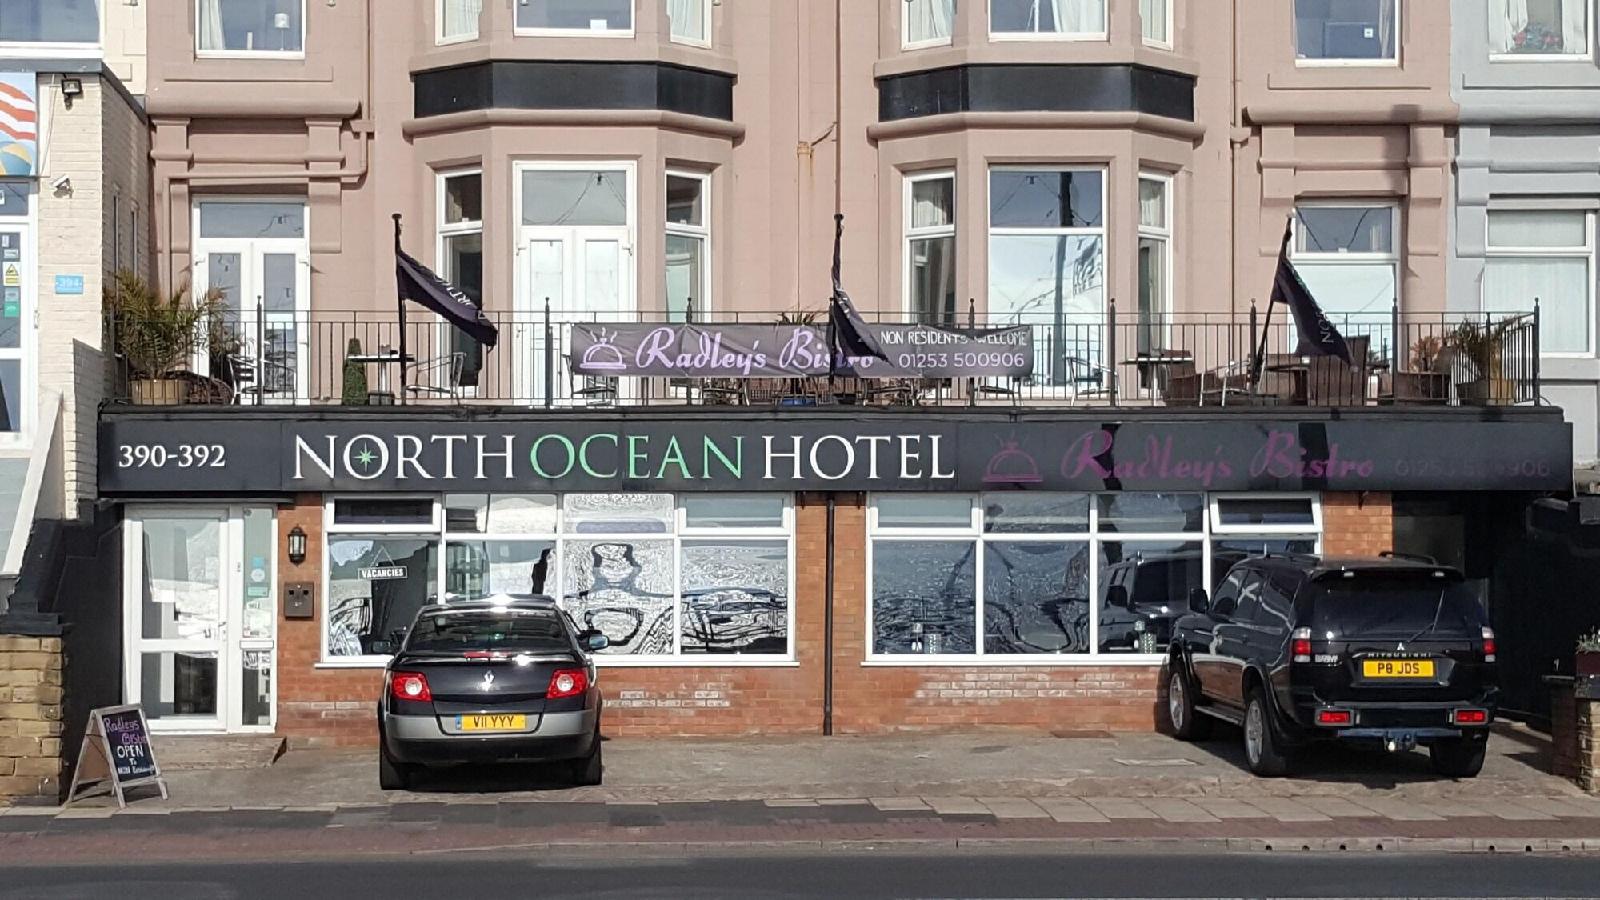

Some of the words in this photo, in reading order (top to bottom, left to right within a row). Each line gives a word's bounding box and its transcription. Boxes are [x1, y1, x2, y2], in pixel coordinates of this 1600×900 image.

[880, 331, 904, 345] NON
[908, 330, 968, 346] RESIDENTS
[635, 326, 768, 375] Radley's
[898, 352, 948, 368] 01253
[953, 352, 1025, 368] 500906
[118, 444, 227, 468] 390-392
[293, 433, 516, 480] NORTH
[530, 433, 745, 480] OCEAN
[762, 433, 955, 480] HOTEL
[1061, 429, 1232, 487] Radley's
[1249, 429, 1376, 480] Bistro
[360, 568, 404, 578] VACANCIES
[1377, 662, 1393, 674] P8
[1397, 662, 1420, 674] JDS
[491, 715, 516, 727] YYY
[117, 745, 144, 758] OPEN
